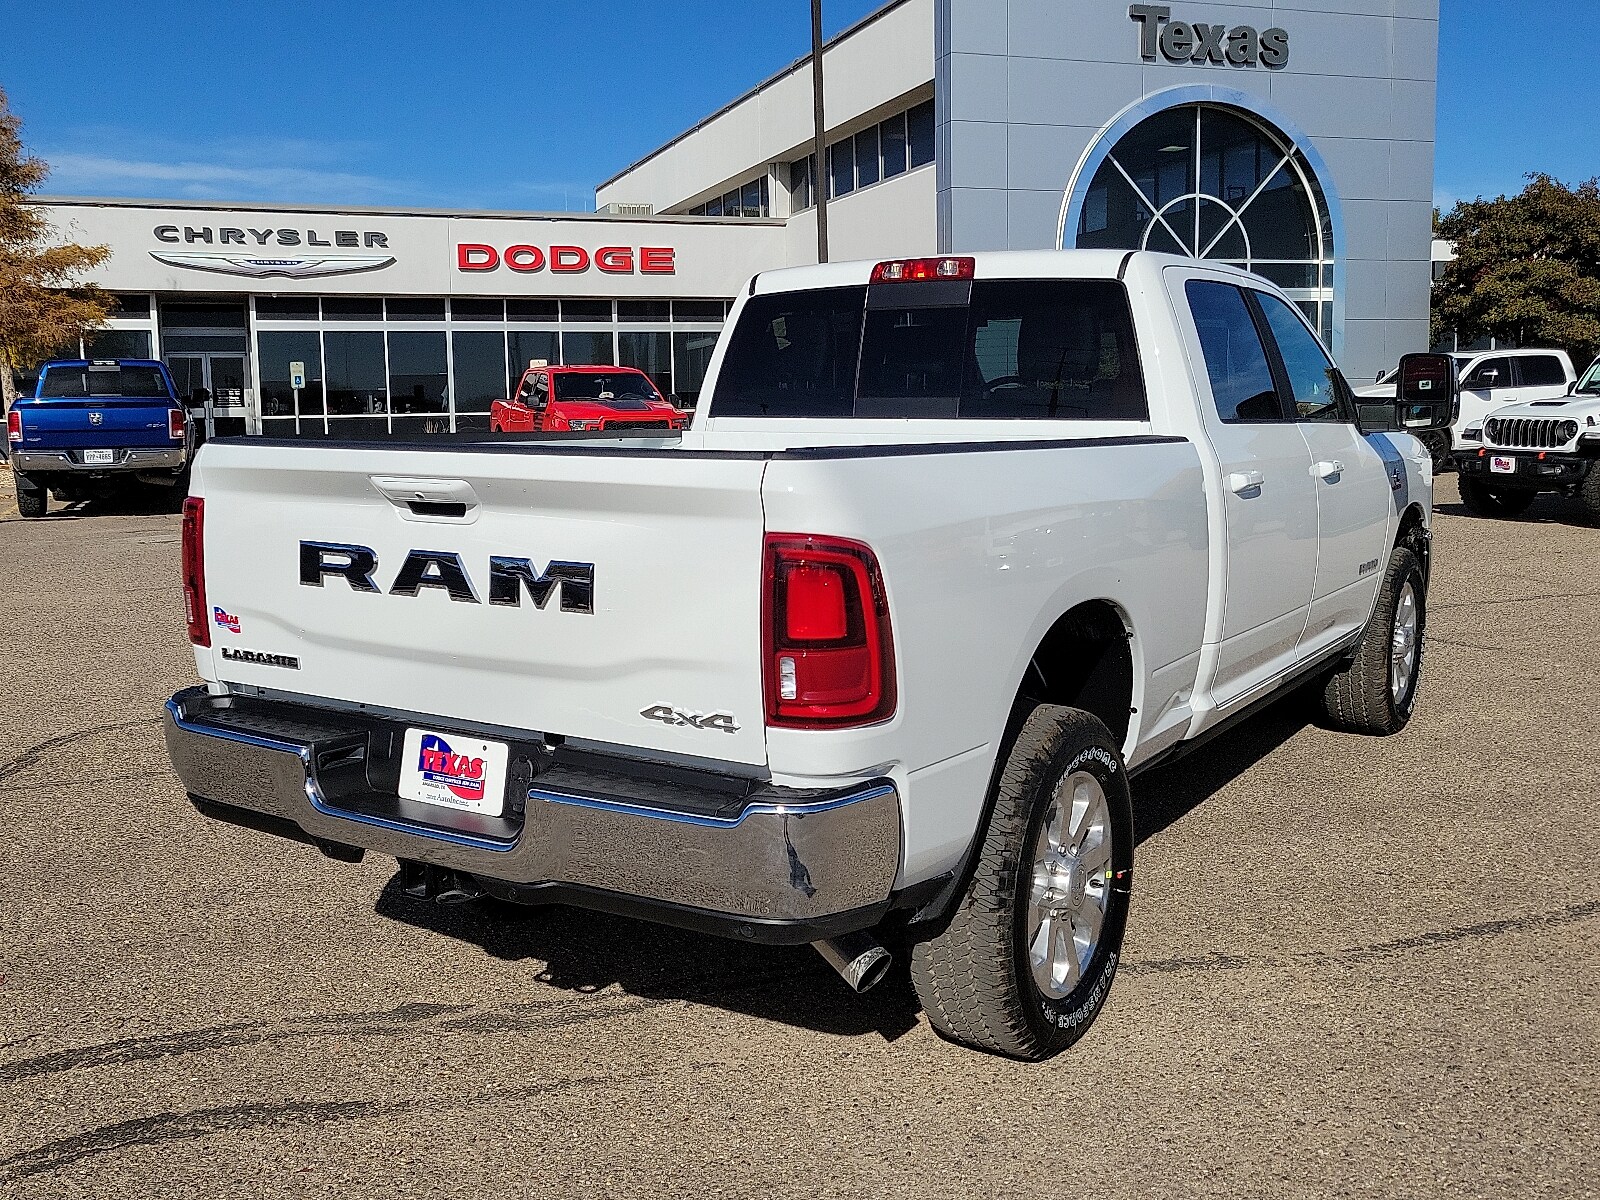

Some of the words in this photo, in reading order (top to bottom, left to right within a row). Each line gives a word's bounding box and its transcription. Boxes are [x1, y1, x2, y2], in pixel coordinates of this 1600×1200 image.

[1129, 4, 1289, 70] Texas
[154, 225, 390, 249] CHRYSLER
[457, 243, 676, 275] DODGE
[299, 540, 595, 615] RAM
[221, 647, 301, 671] LARAMIE
[422, 748, 484, 780] TEXAS
